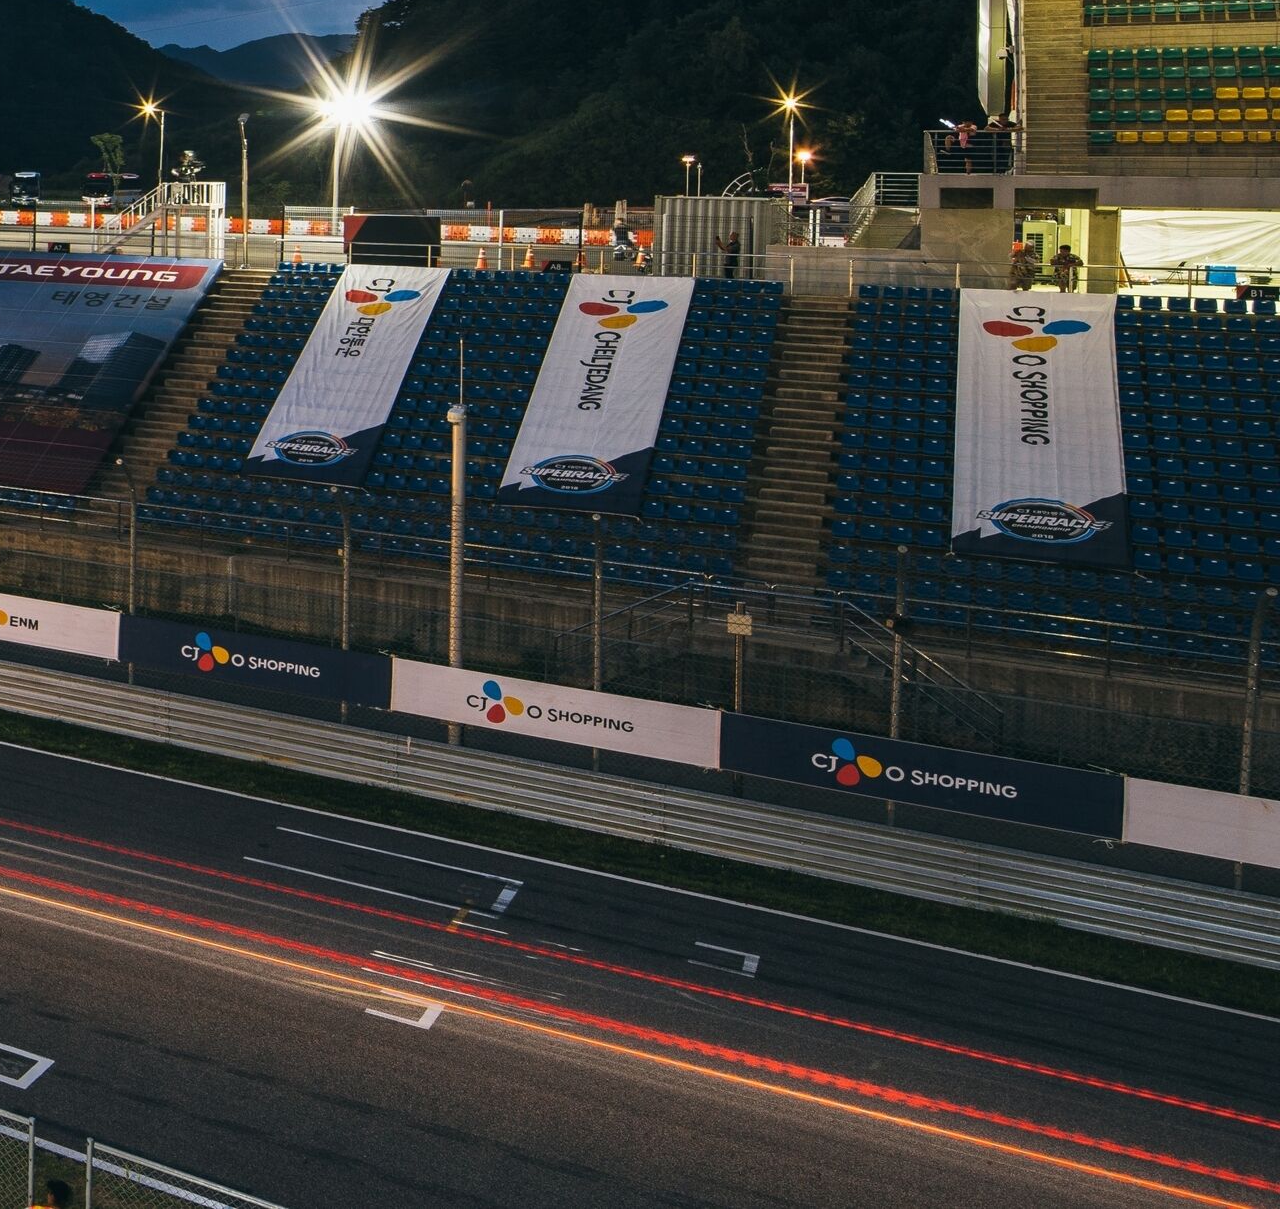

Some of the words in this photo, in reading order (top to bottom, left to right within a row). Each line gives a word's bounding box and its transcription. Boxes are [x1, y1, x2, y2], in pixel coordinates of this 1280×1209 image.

[550, 263, 561, 271] A8
[365, 277, 395, 293] CJ
[1250, 289, 1264, 298] B1
[51, 289, 173, 311] 태영건설
[602, 289, 635, 304] CJ
[1006, 305, 1046, 325] CJ
[335, 316, 376, 358] 대한통운
[1012, 354, 1047, 367] O
[578, 330, 620, 412] CHEILJEDANG
[1012, 370, 1051, 446] SHOPPING
[1011, 523, 1072, 532] CHAMPIONSHIP
[10, 615, 39, 631] ENM
[181, 644, 200, 663] CJ
[231, 653, 245, 668] O
[248, 654, 321, 678] SHOPPING
[466, 693, 488, 712] CJ
[526, 704, 543, 720] O
[547, 707, 635, 734] SHOPPING
[811, 752, 839, 773] CJ
[885, 765, 905, 782] O
[910, 769, 1018, 799] SHOPPING
